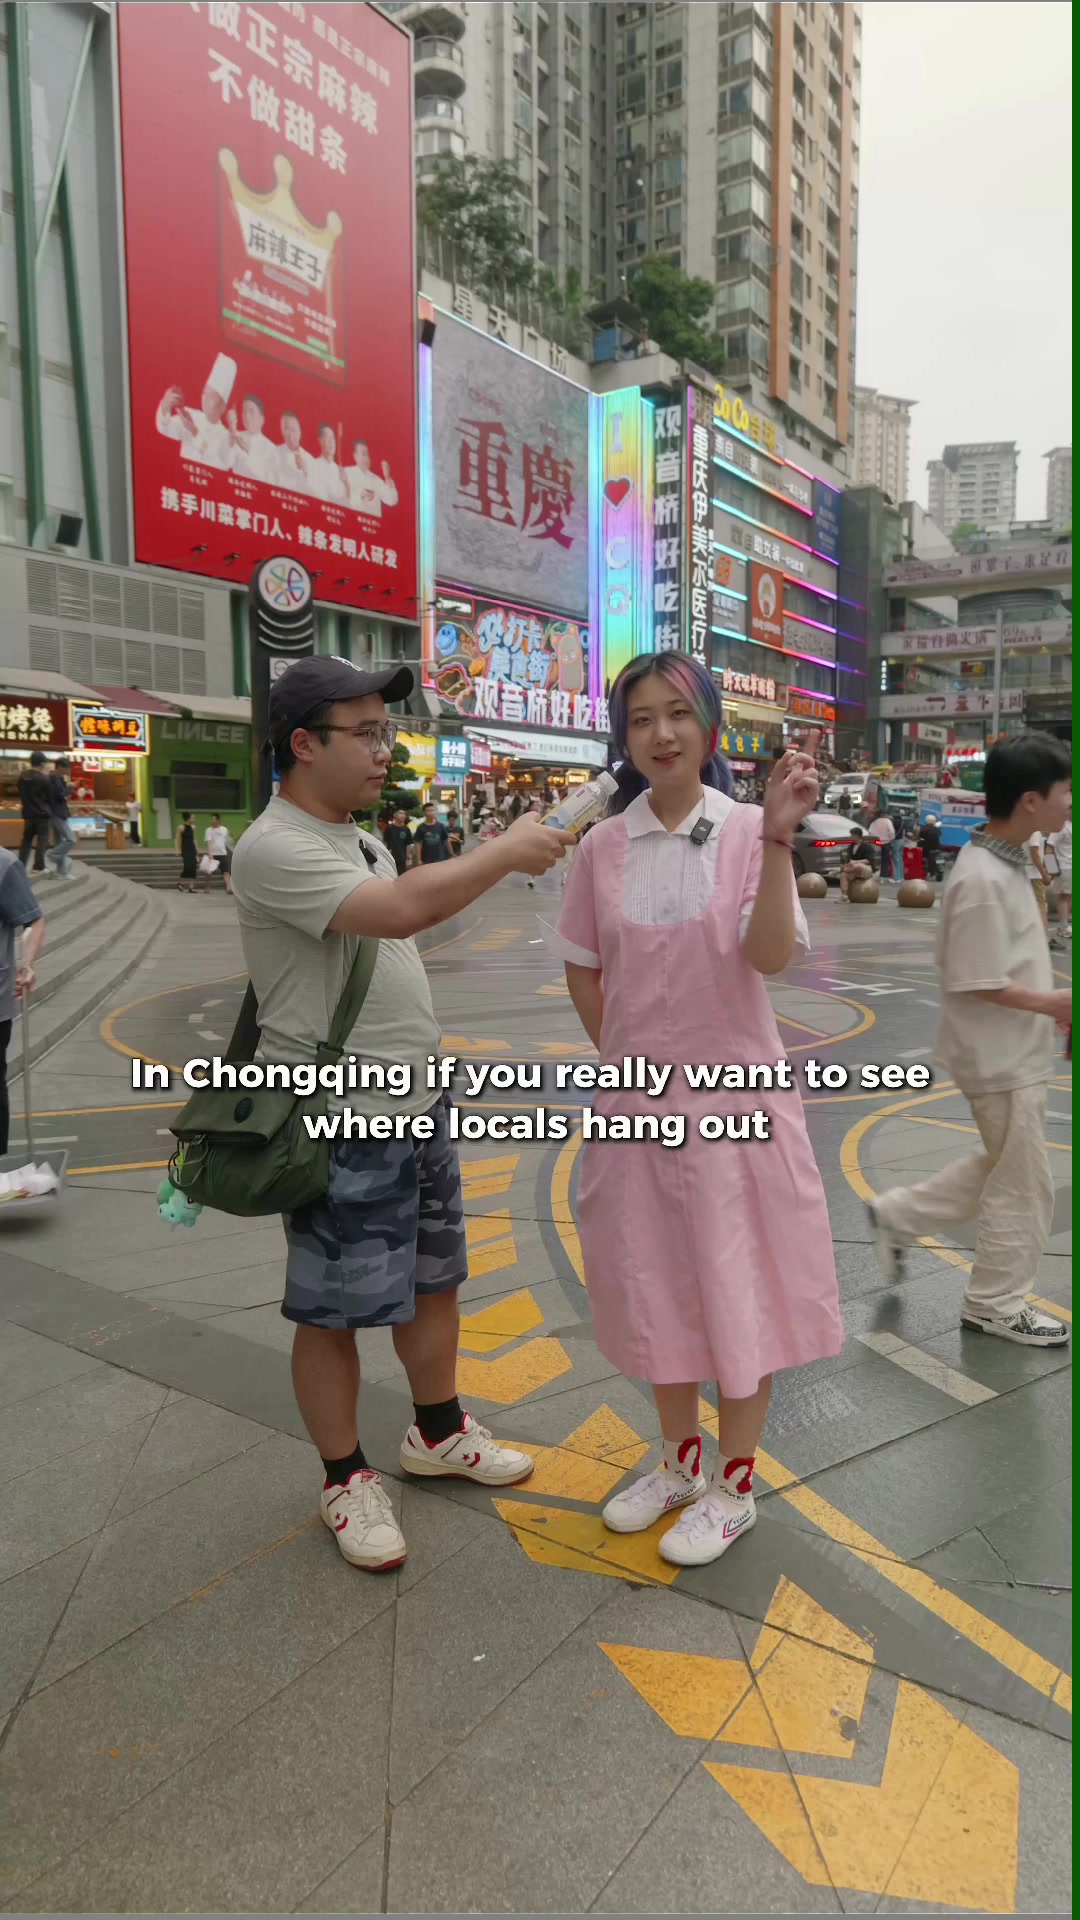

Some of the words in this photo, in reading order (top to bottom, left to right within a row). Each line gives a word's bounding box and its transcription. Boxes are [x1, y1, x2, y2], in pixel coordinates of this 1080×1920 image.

[189, 3, 379, 135] 做正宗麻辣
[208, 48, 348, 175] 不做甜条
[248, 222, 323, 282] 麻辣王子
[452, 418, 575, 551] 重慶
[653, 404, 682, 652] 观音桥好吃街
[474, 676, 611, 734] 观音桥好吃街
